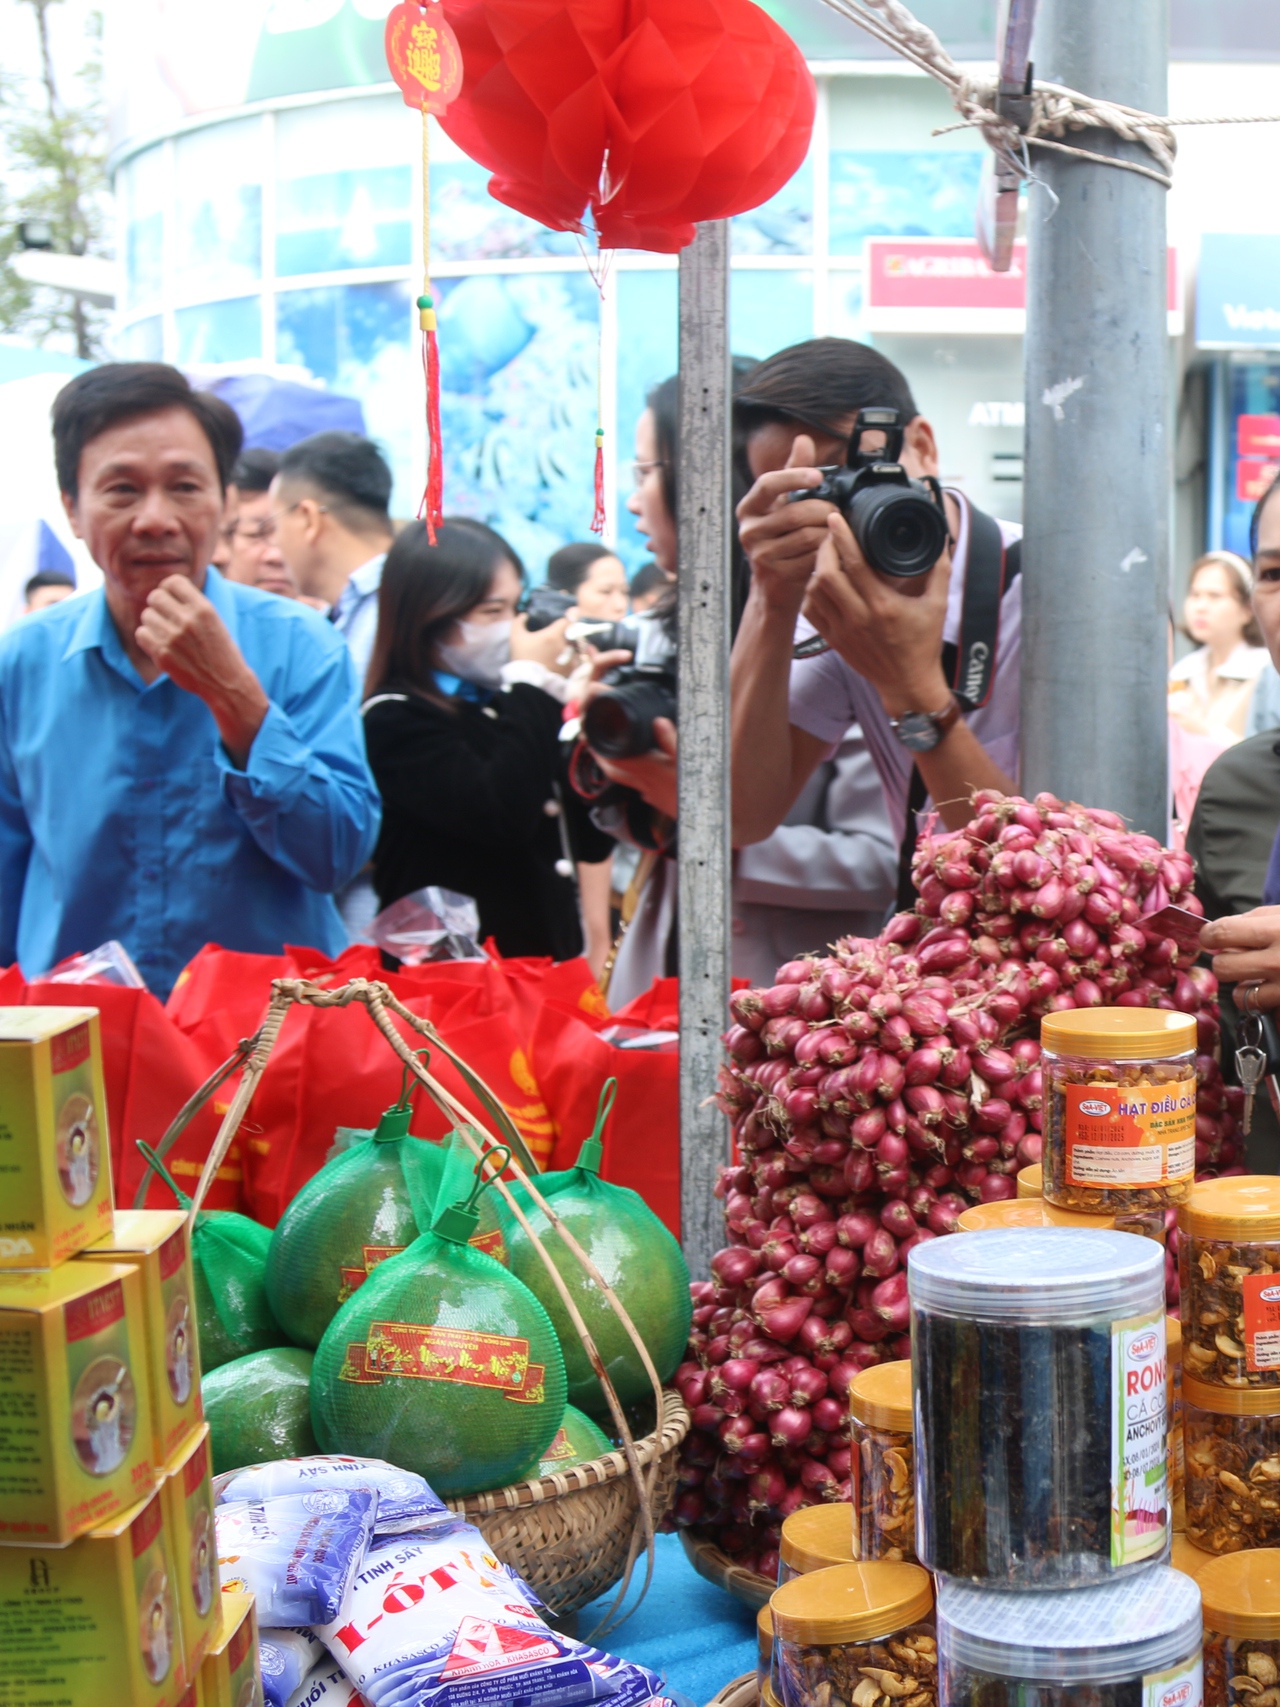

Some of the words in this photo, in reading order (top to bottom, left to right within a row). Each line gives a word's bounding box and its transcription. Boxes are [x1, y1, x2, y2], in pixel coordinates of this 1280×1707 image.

[906, 256, 1022, 277] AGRIBAK
[968, 402, 1025, 426] ATM
[964, 641, 989, 704] Cano
[1118, 1102, 1146, 1118] HẠT
[1151, 1095, 1177, 1114] ĐIỀU
[1127, 1398, 1148, 1421] CÁ
[1126, 1417, 1161, 1443] ANCHOVY
[358, 1560, 394, 1586] TINH
[395, 1546, 423, 1564] SẤY
[372, 1643, 440, 1674] KHASASCO
[506, 1647, 550, 1665] KHASASCO
